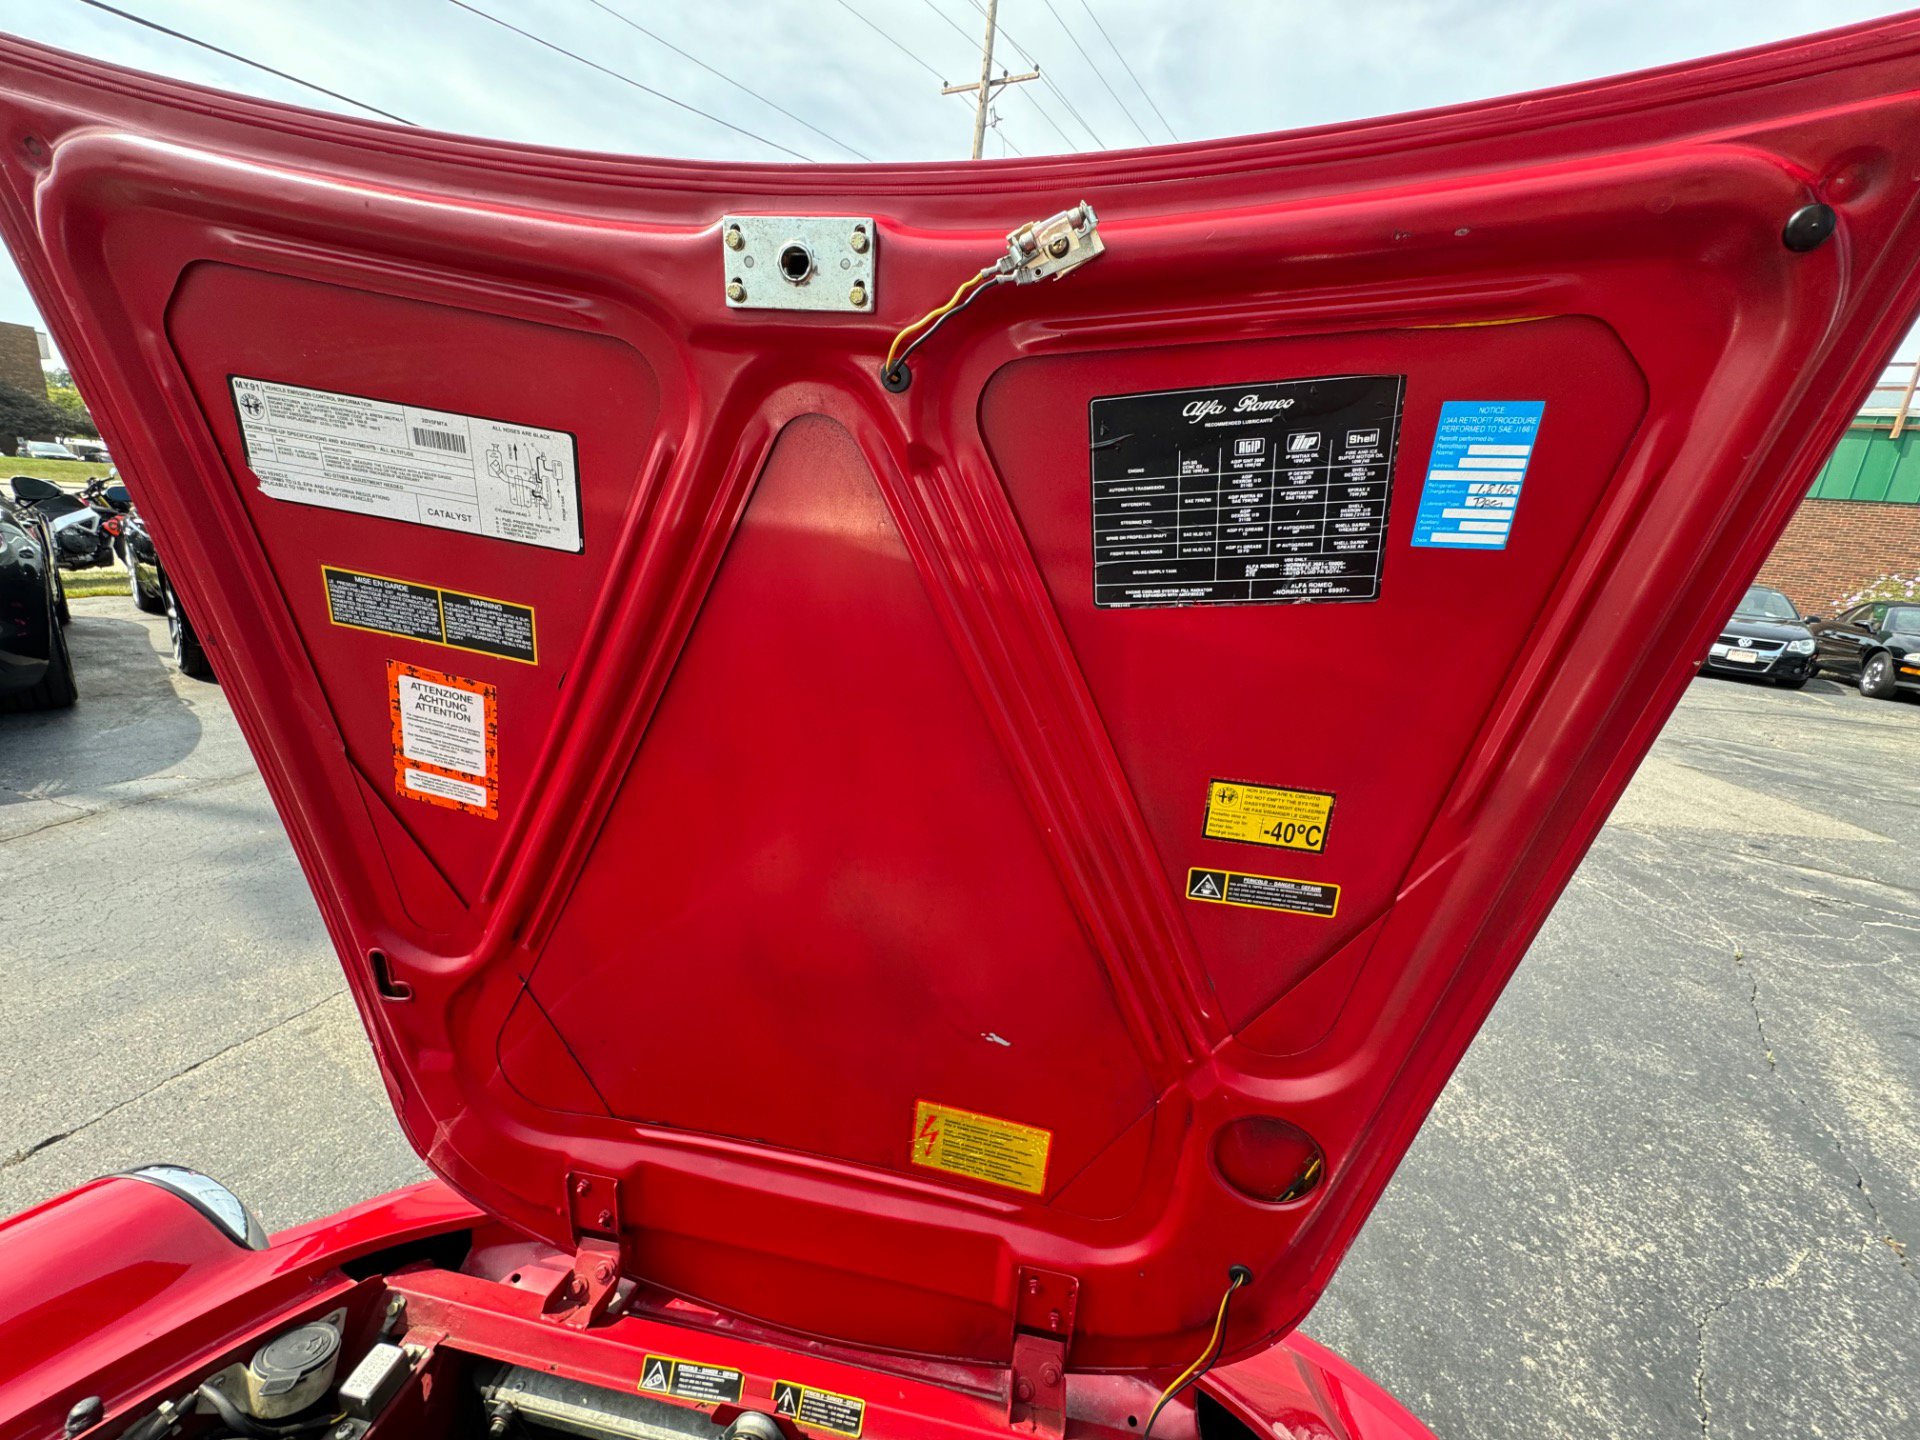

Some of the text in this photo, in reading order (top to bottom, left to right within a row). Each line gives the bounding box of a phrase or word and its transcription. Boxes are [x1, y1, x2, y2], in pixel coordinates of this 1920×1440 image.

[337, 398, 372, 408] INFORMATION
[1182, 394, 1295, 424] Alfa Romeo
[1478, 406, 1506, 414] NOTICE
[1204, 418, 1273, 428] RECOMMENDED LUBRICANTS
[1458, 416, 1493, 424] RETROFIT
[1494, 416, 1537, 424] PROCEDURE
[503, 427, 520, 436] HOSES
[533, 431, 550, 440] BLACK
[1348, 433, 1376, 444] Shell
[1238, 440, 1260, 454] AGIP
[427, 508, 472, 522] CATALYST
[354, 576, 372, 584] MISE
[372, 579, 383, 587] EN
[384, 582, 408, 592] GARDE
[469, 598, 502, 612] WARNING
[410, 682, 474, 705] ATTENZIONE
[418, 693, 468, 712] ACHTUNG
[415, 702, 471, 723] ATTENTION
[1297, 800, 1320, 808] SYSTEM
[1264, 821, 1322, 847] -40°C
[1244, 878, 1268, 886] PERICOLO
[678, 1364, 698, 1372] PERICOLO
[702, 1368, 718, 1376] DANGER
[804, 1390, 824, 1399] PERICOLO
[827, 1394, 844, 1404] DANGER
